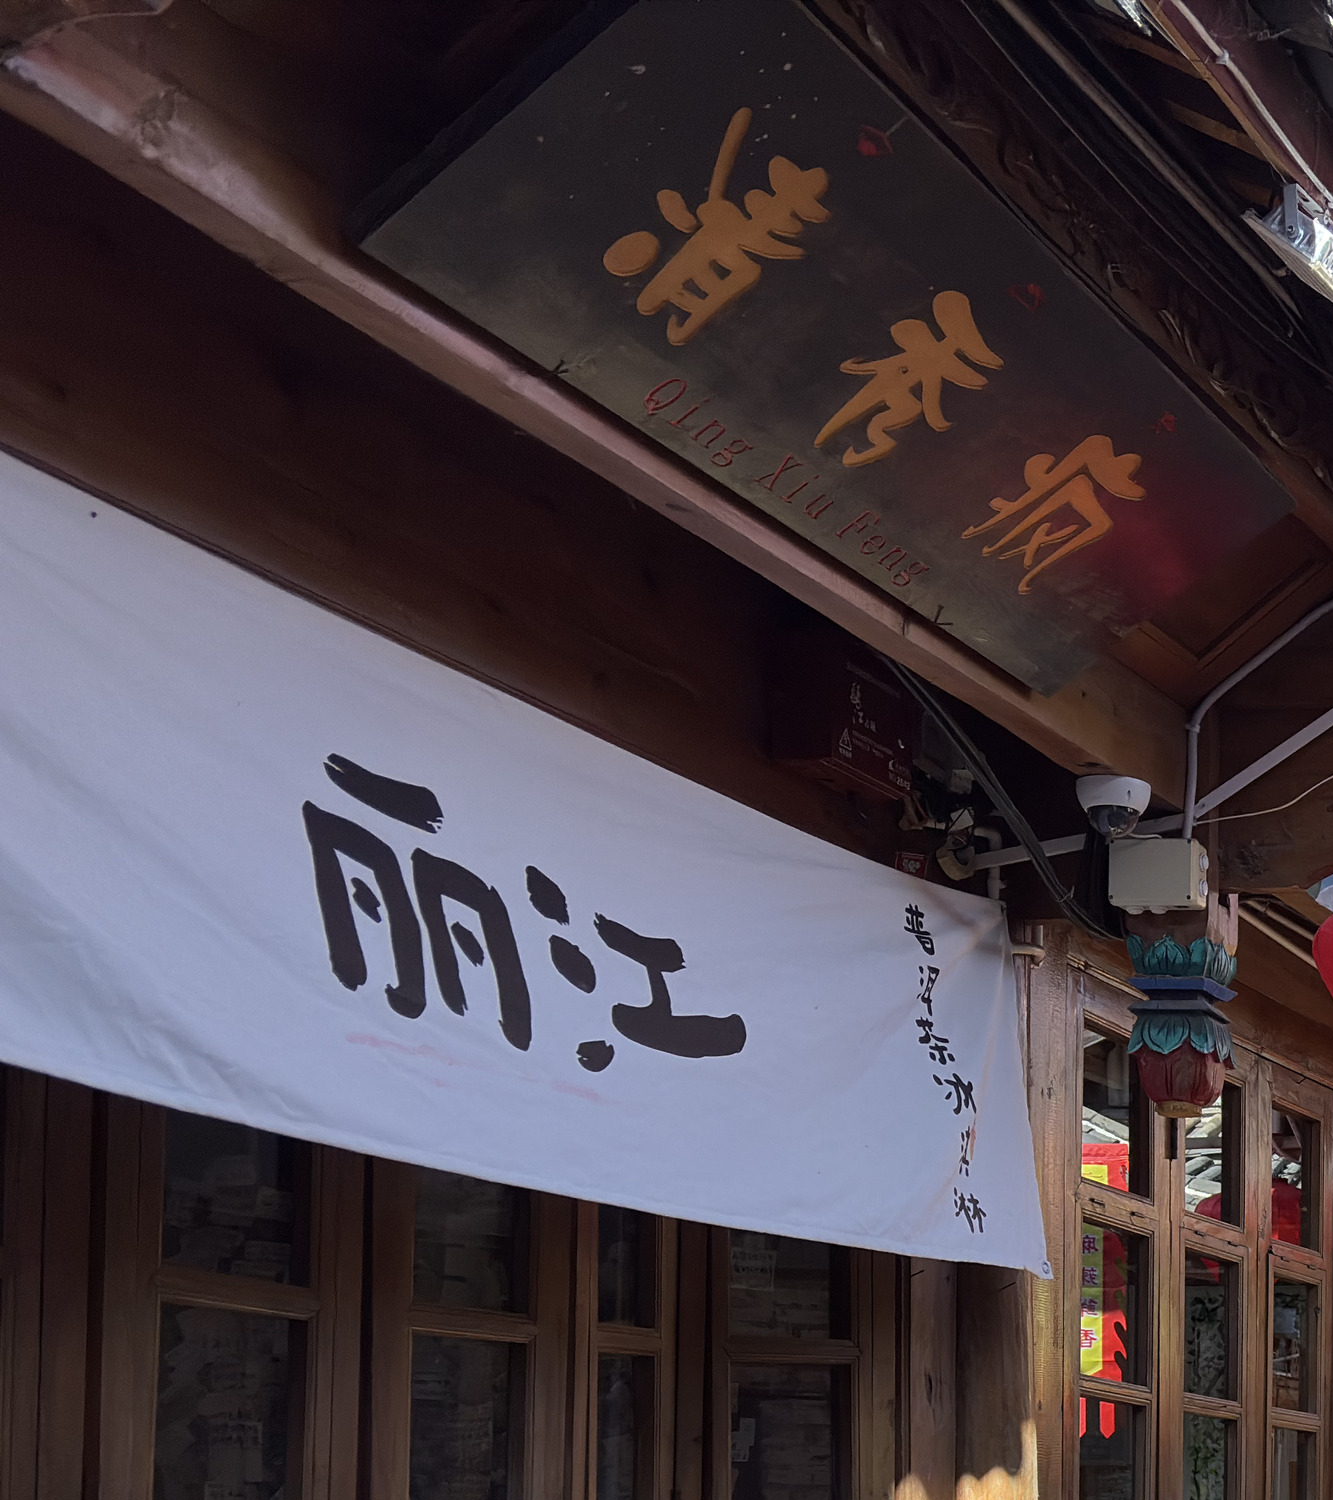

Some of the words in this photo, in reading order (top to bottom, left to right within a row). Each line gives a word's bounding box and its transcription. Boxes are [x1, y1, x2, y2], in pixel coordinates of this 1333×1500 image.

[643, 377, 753, 467] Qing
[753, 454, 833, 520] Xiu
[834, 510, 930, 587] Feng
[302, 753, 746, 1073] 丽江
[904, 903, 988, 1234] 普洱茶冰淇淋
